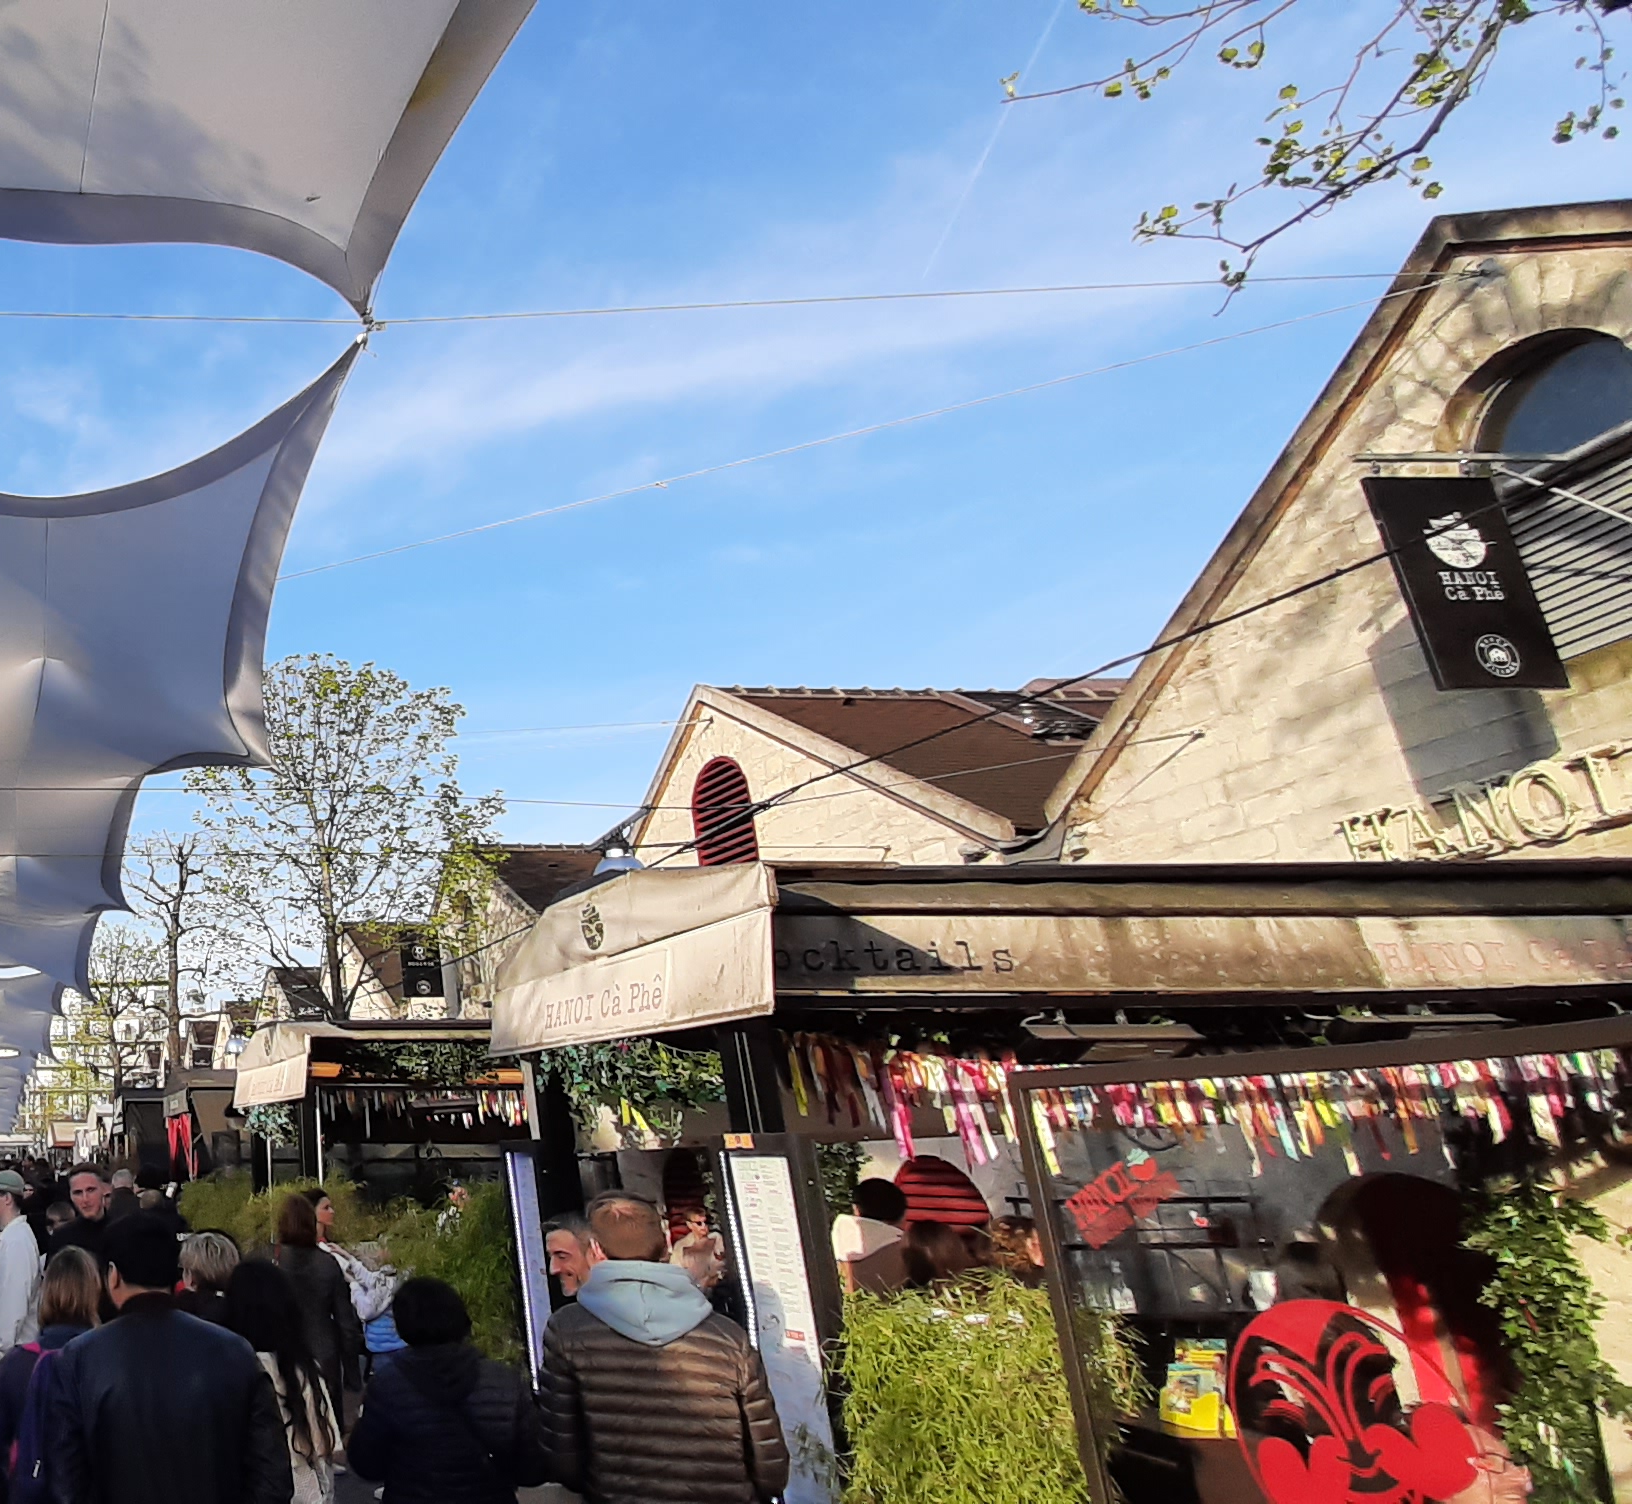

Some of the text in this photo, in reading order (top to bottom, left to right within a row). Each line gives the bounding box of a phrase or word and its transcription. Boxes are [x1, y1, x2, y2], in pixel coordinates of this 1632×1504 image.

[1436, 571, 1500, 585] HANOI
[1333, 747, 1632, 862] HANOI
[545, 973, 662, 1029] HANOI Cà Phê
